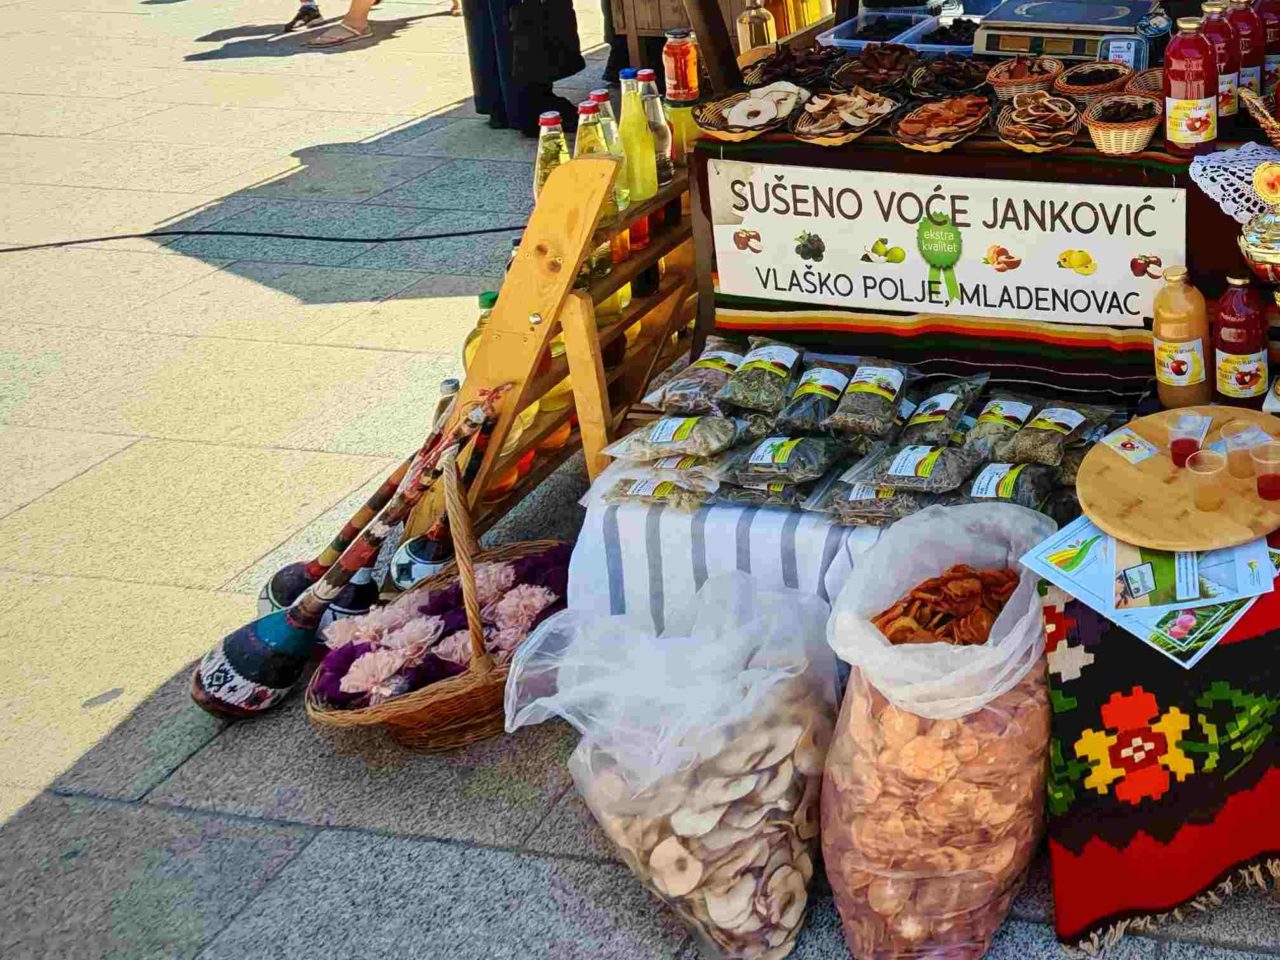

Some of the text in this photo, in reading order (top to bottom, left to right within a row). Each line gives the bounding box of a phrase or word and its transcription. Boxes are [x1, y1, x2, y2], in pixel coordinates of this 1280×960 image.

[730, 174, 1157, 238] SUŠENO VOĆE JANKOVIĆ
[921, 241, 958, 254] kvalitet
[923, 229, 955, 241] ekstra
[755, 264, 1141, 316] VLAŠKO POLJE, MLADENOVAC
